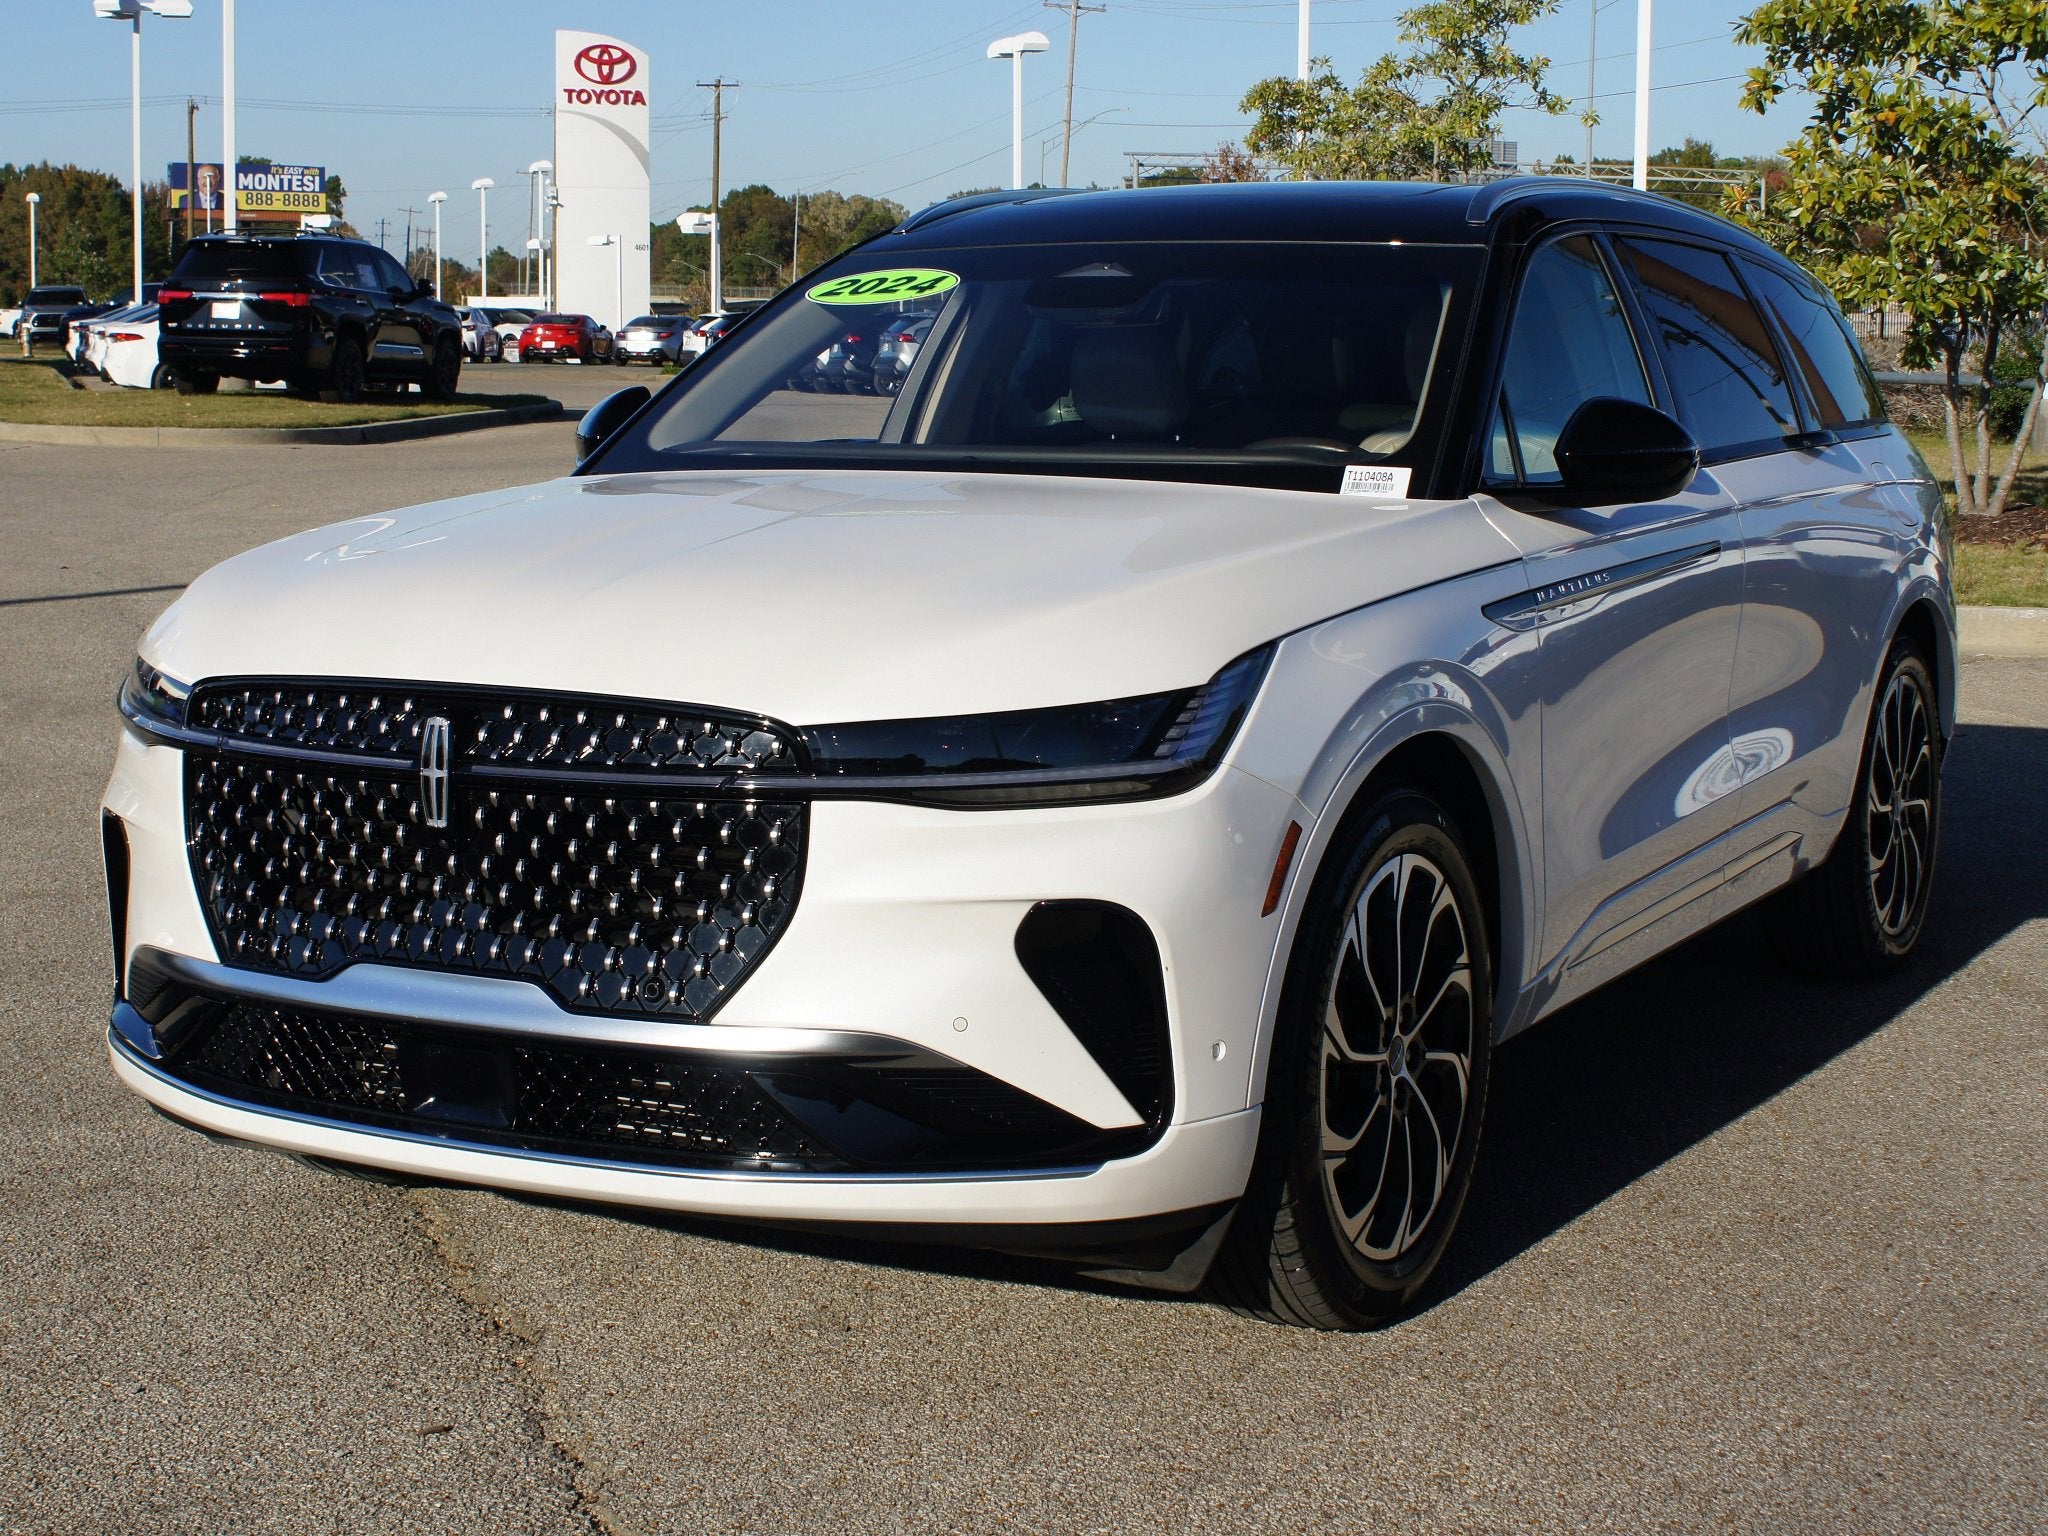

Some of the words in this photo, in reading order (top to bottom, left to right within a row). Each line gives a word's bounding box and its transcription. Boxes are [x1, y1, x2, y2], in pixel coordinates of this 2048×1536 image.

[563, 88, 647, 106] TOYOTA
[271, 166, 283, 175] It's
[284, 166, 303, 175] EASY
[304, 167, 320, 175] with
[238, 173, 320, 192] MONTESI
[245, 192, 321, 208] 888-8888
[815, 275, 951, 298] 2024
[1347, 470, 1394, 483] T110408A
[1536, 572, 1611, 602] NAUTILUS
